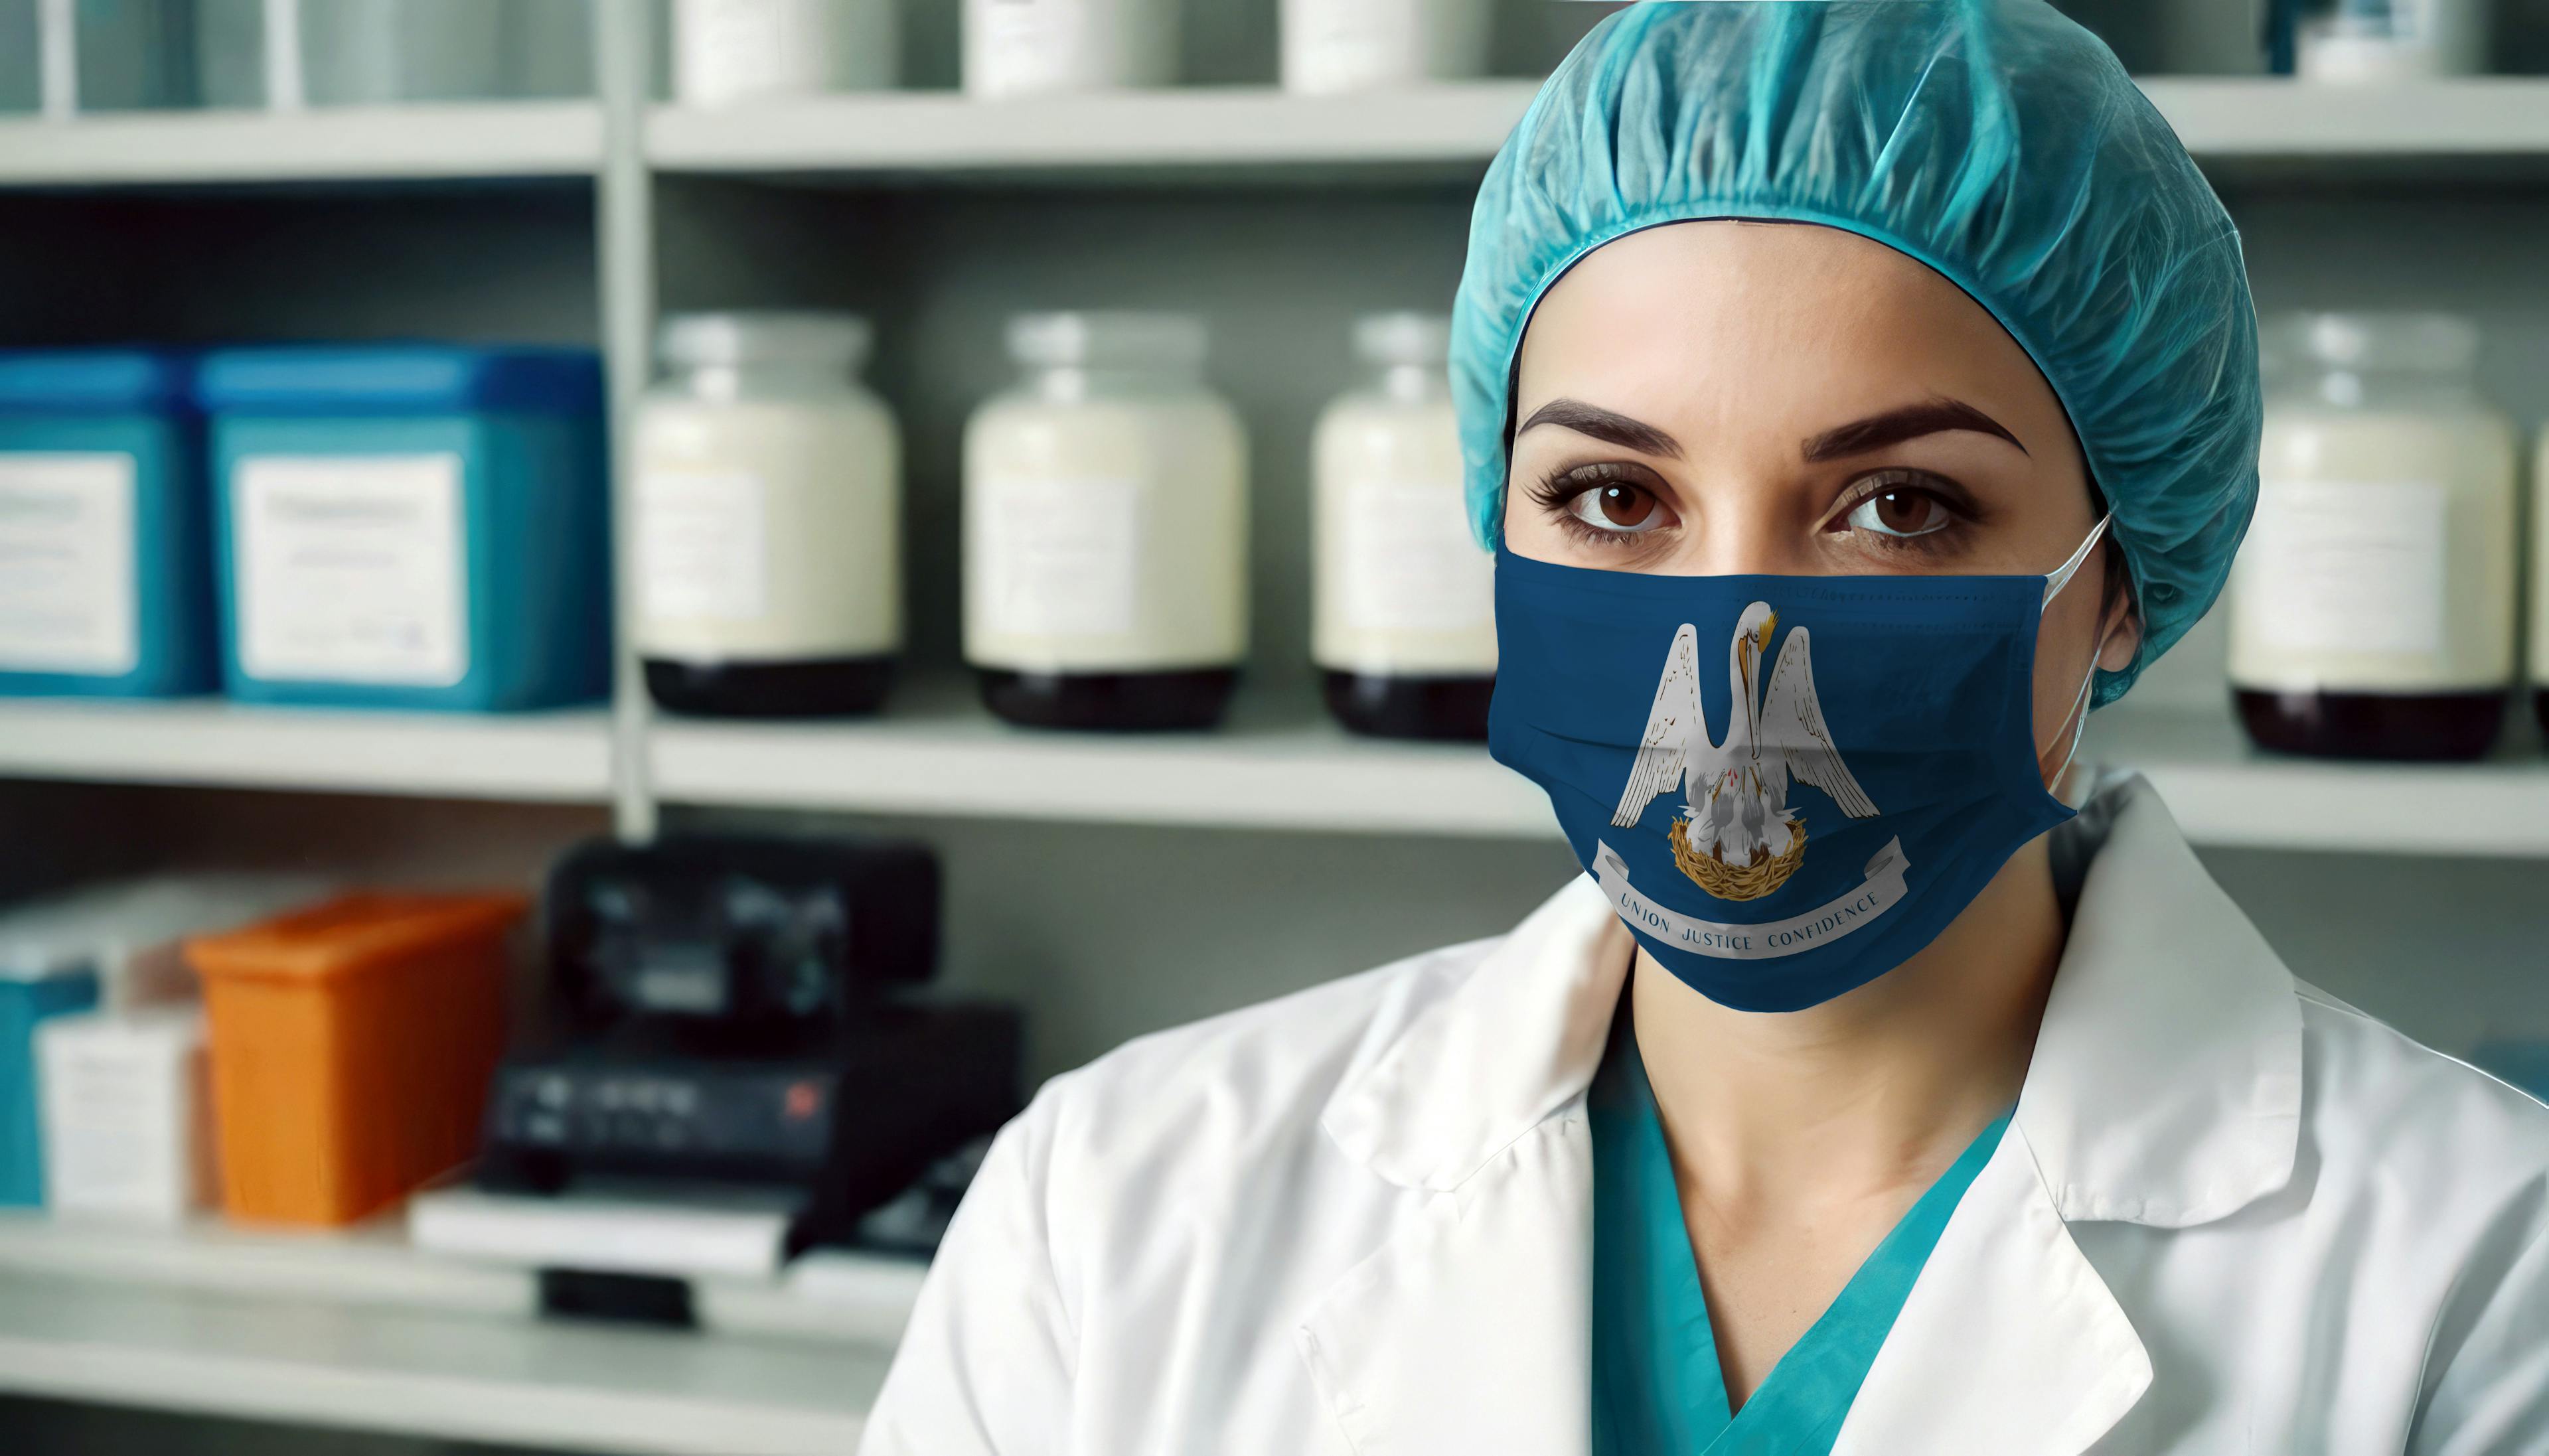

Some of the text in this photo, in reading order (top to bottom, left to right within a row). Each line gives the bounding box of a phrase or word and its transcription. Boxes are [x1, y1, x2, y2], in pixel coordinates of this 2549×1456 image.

[1621, 891, 1880, 950] UNION JUSTICE CONFIDENCE
